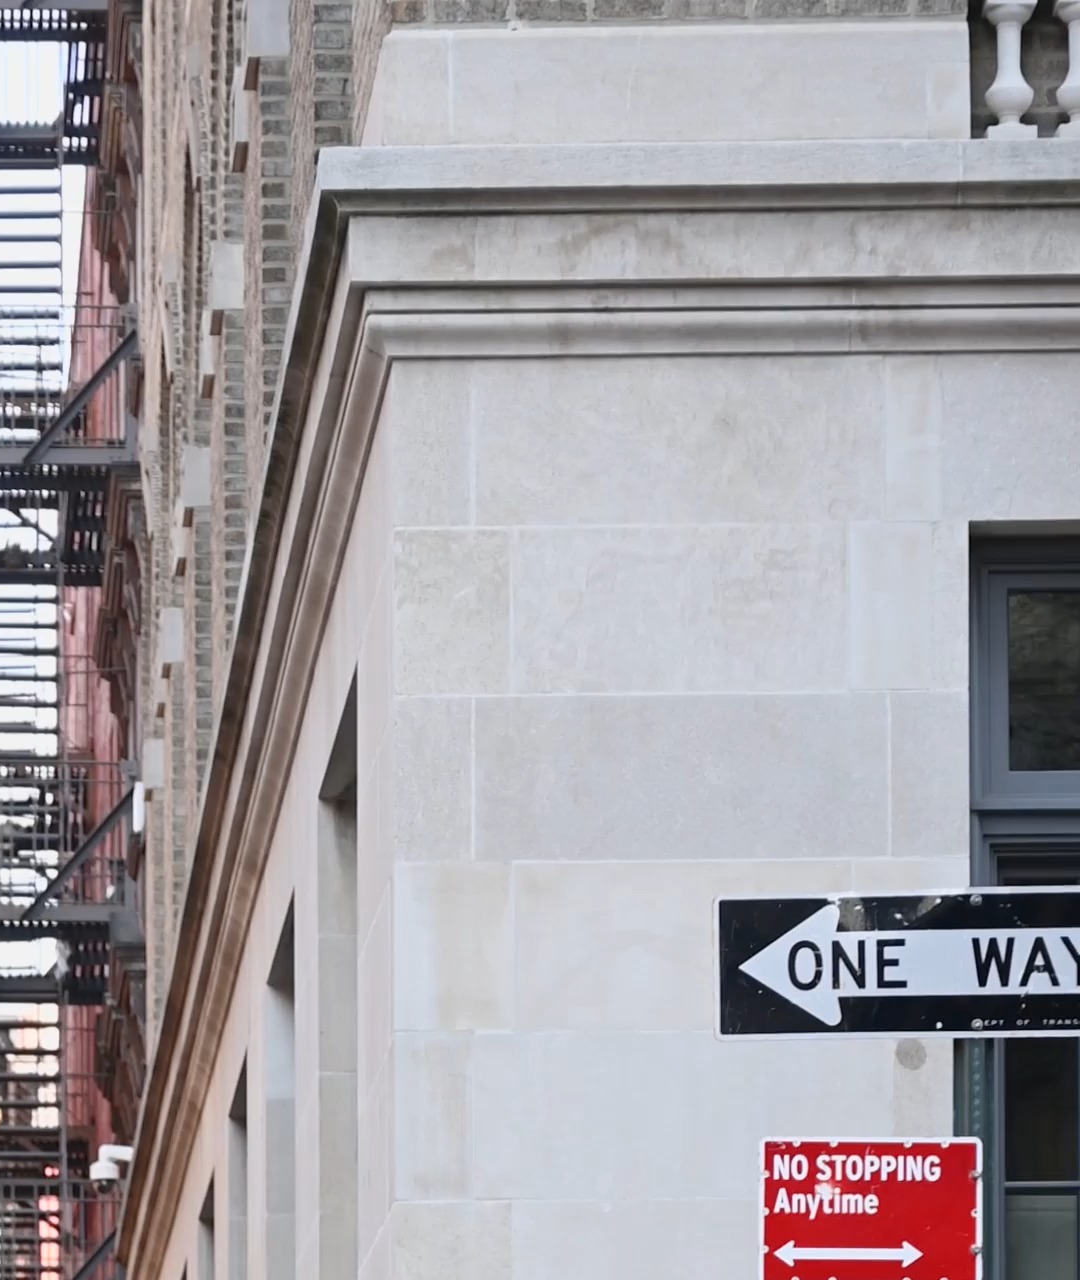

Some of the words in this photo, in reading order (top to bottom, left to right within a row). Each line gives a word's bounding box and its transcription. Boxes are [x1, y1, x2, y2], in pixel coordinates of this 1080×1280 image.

[788, 939, 908, 991] ONE
[773, 1154, 809, 1181] NO
[816, 1154, 941, 1182] STOPPING
[773, 1187, 880, 1220] Anytime
